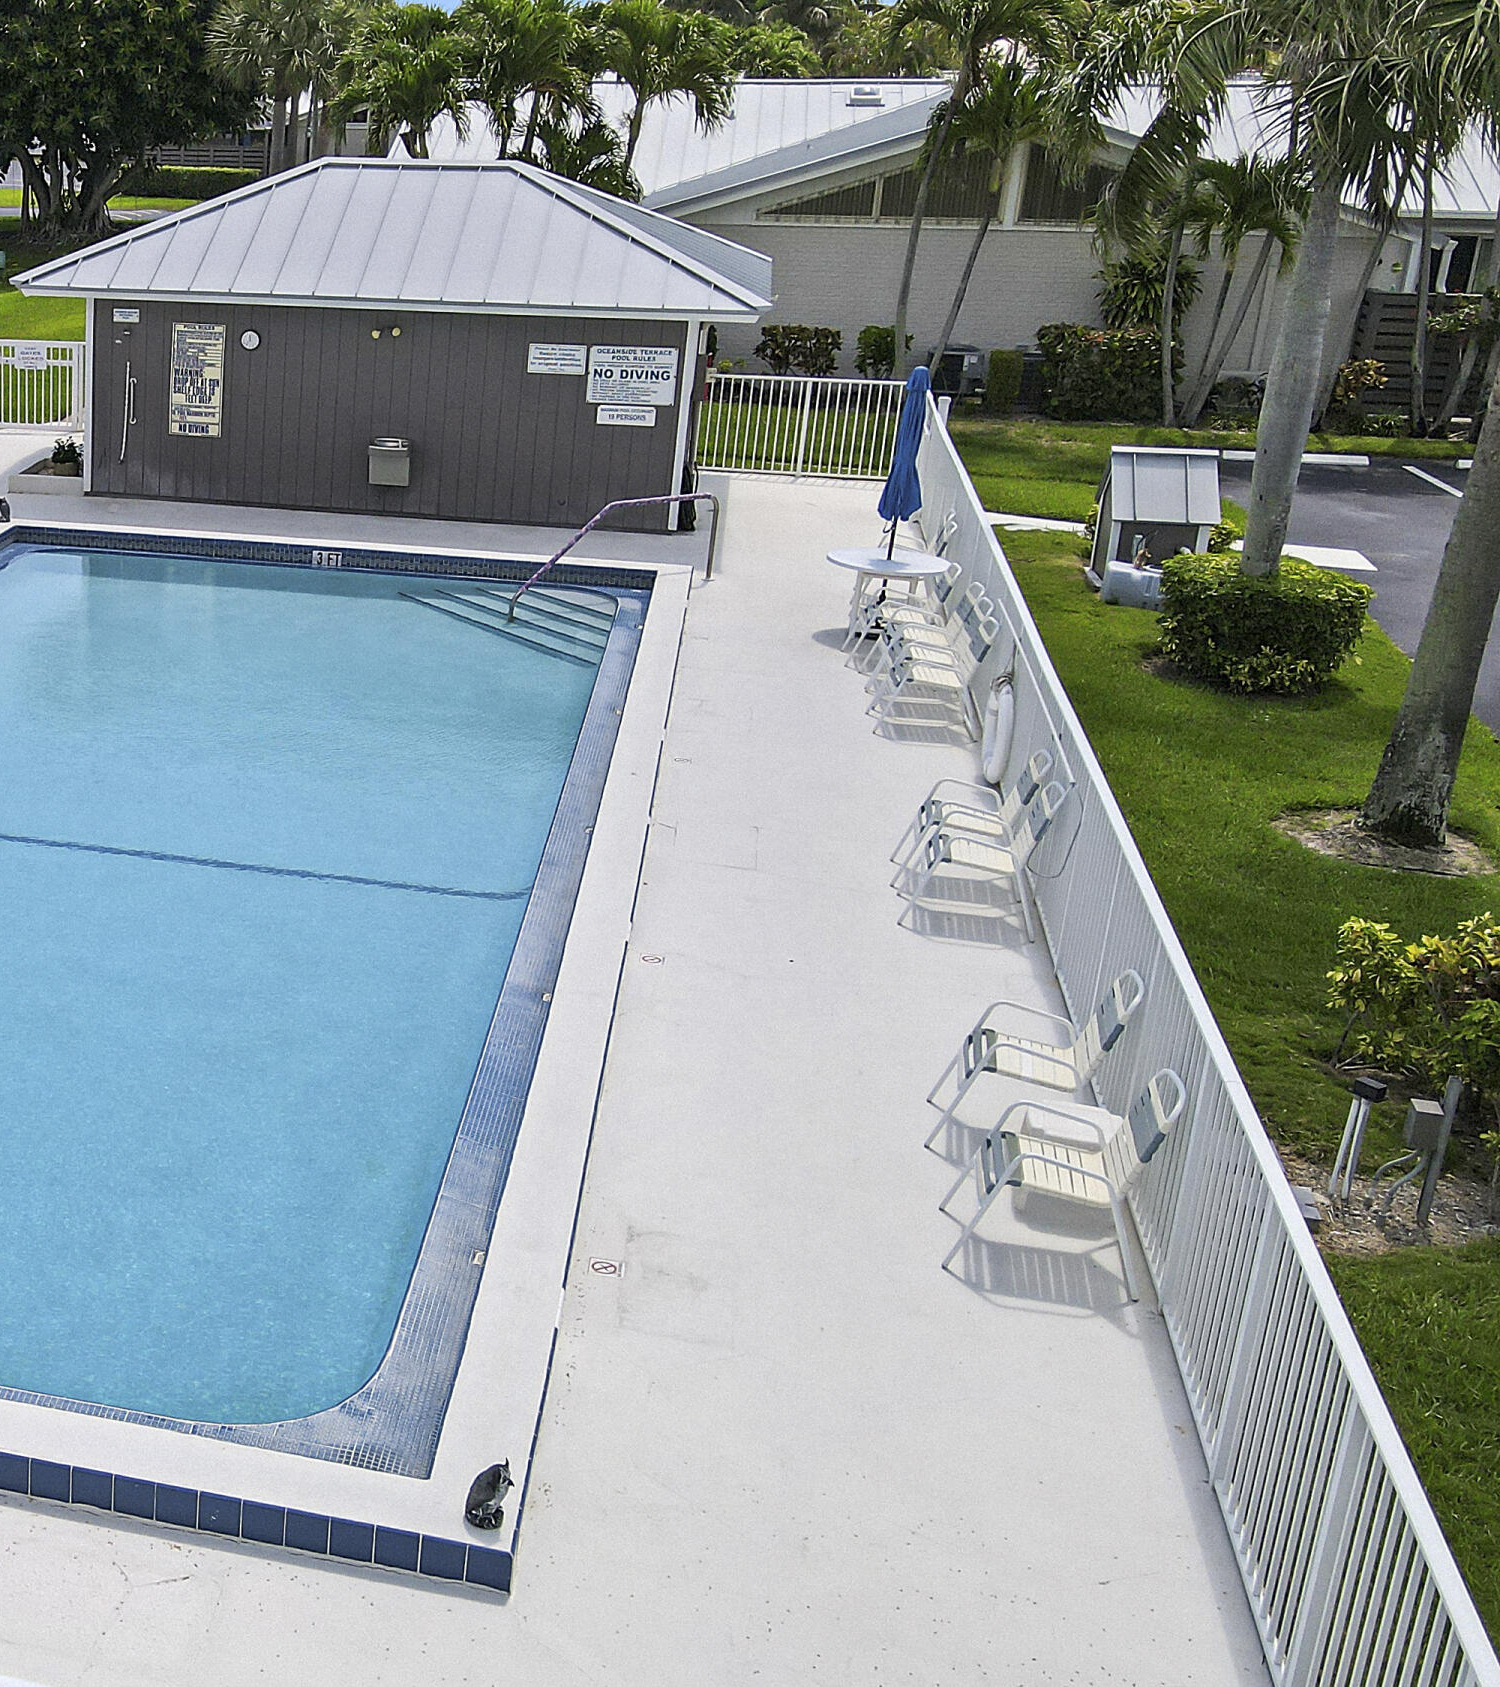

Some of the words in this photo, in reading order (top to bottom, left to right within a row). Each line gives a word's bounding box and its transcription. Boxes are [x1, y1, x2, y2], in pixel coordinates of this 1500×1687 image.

[593, 368, 614, 379] NO
[620, 369, 671, 381] DIVING
[178, 423, 187, 432] NO
[188, 424, 210, 434] DIVING
[316, 552, 323, 565] 3
[327, 552, 341, 567] FT
